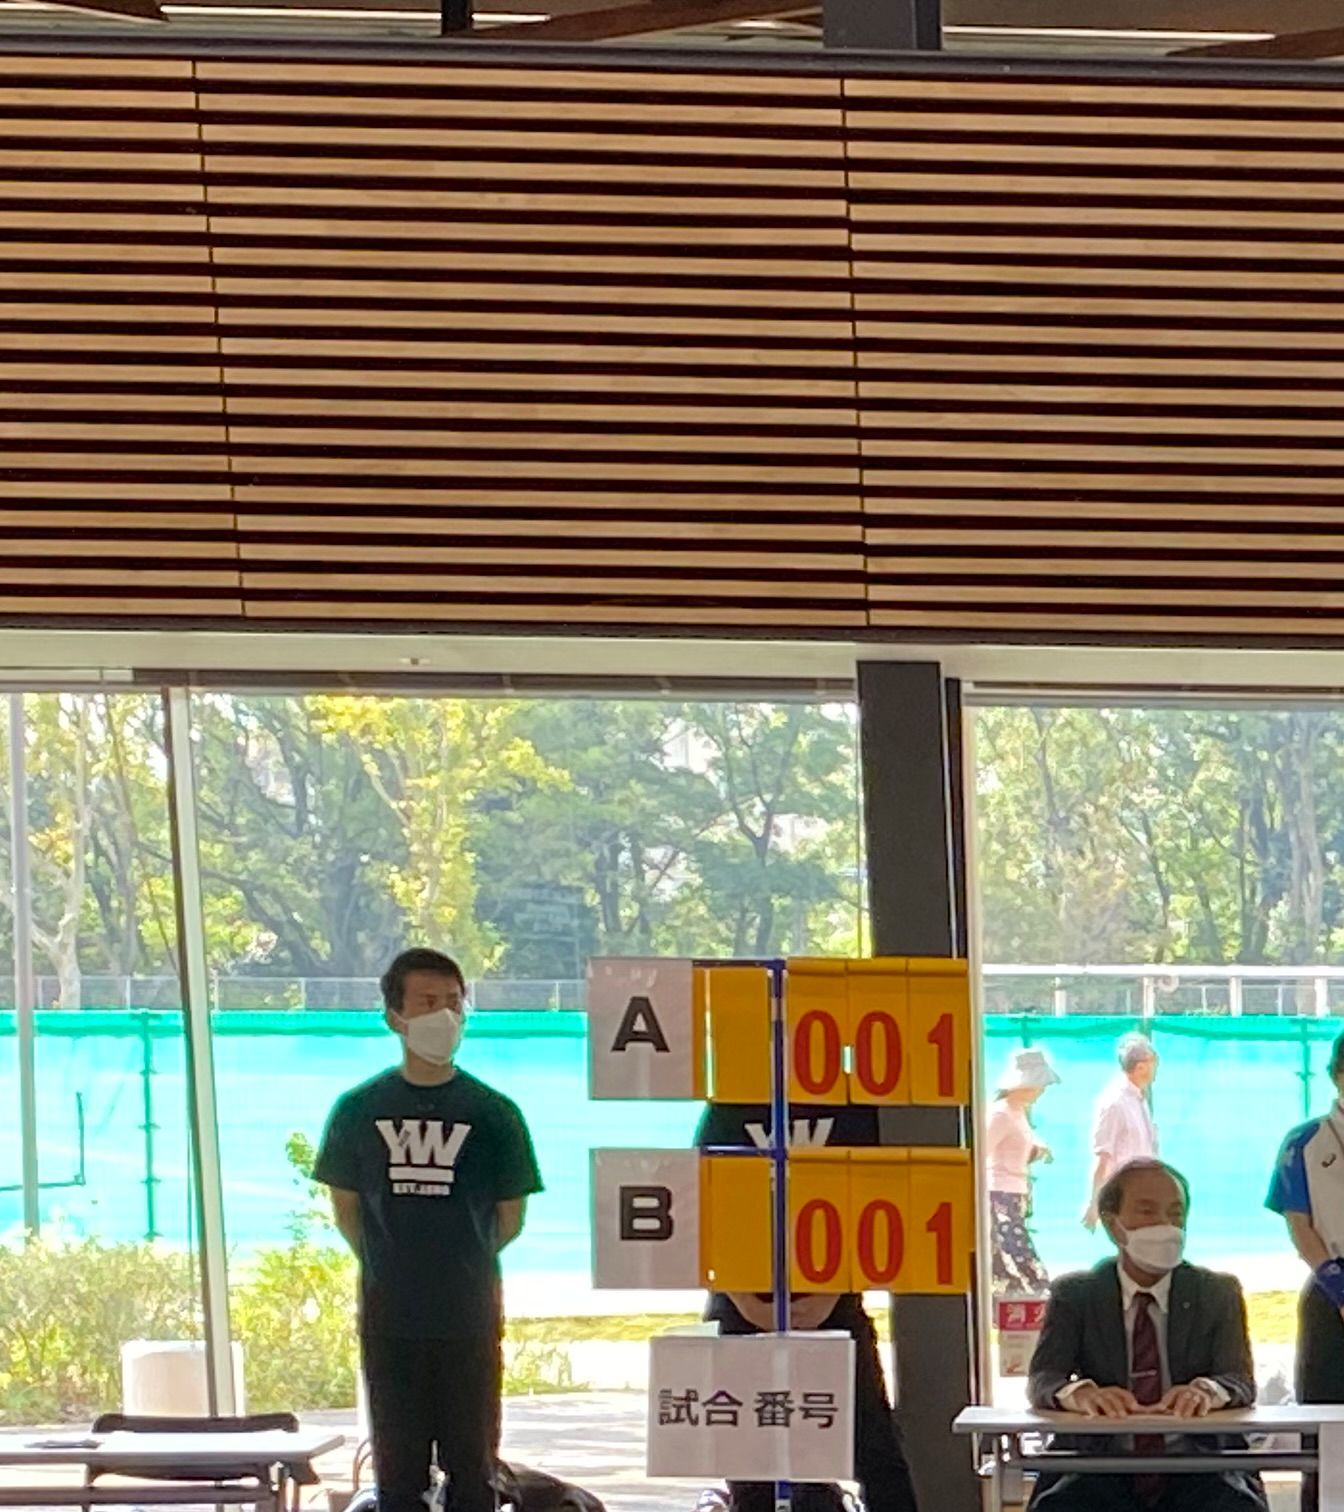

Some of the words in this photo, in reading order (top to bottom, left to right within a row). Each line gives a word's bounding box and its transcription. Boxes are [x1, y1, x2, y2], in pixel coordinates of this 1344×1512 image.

[610, 996, 670, 1053] A
[793, 1009, 955, 1097] 001
[619, 1185, 674, 1241] B
[794, 1199, 953, 1286] 001
[658, 1388, 839, 1429] 試合番号
